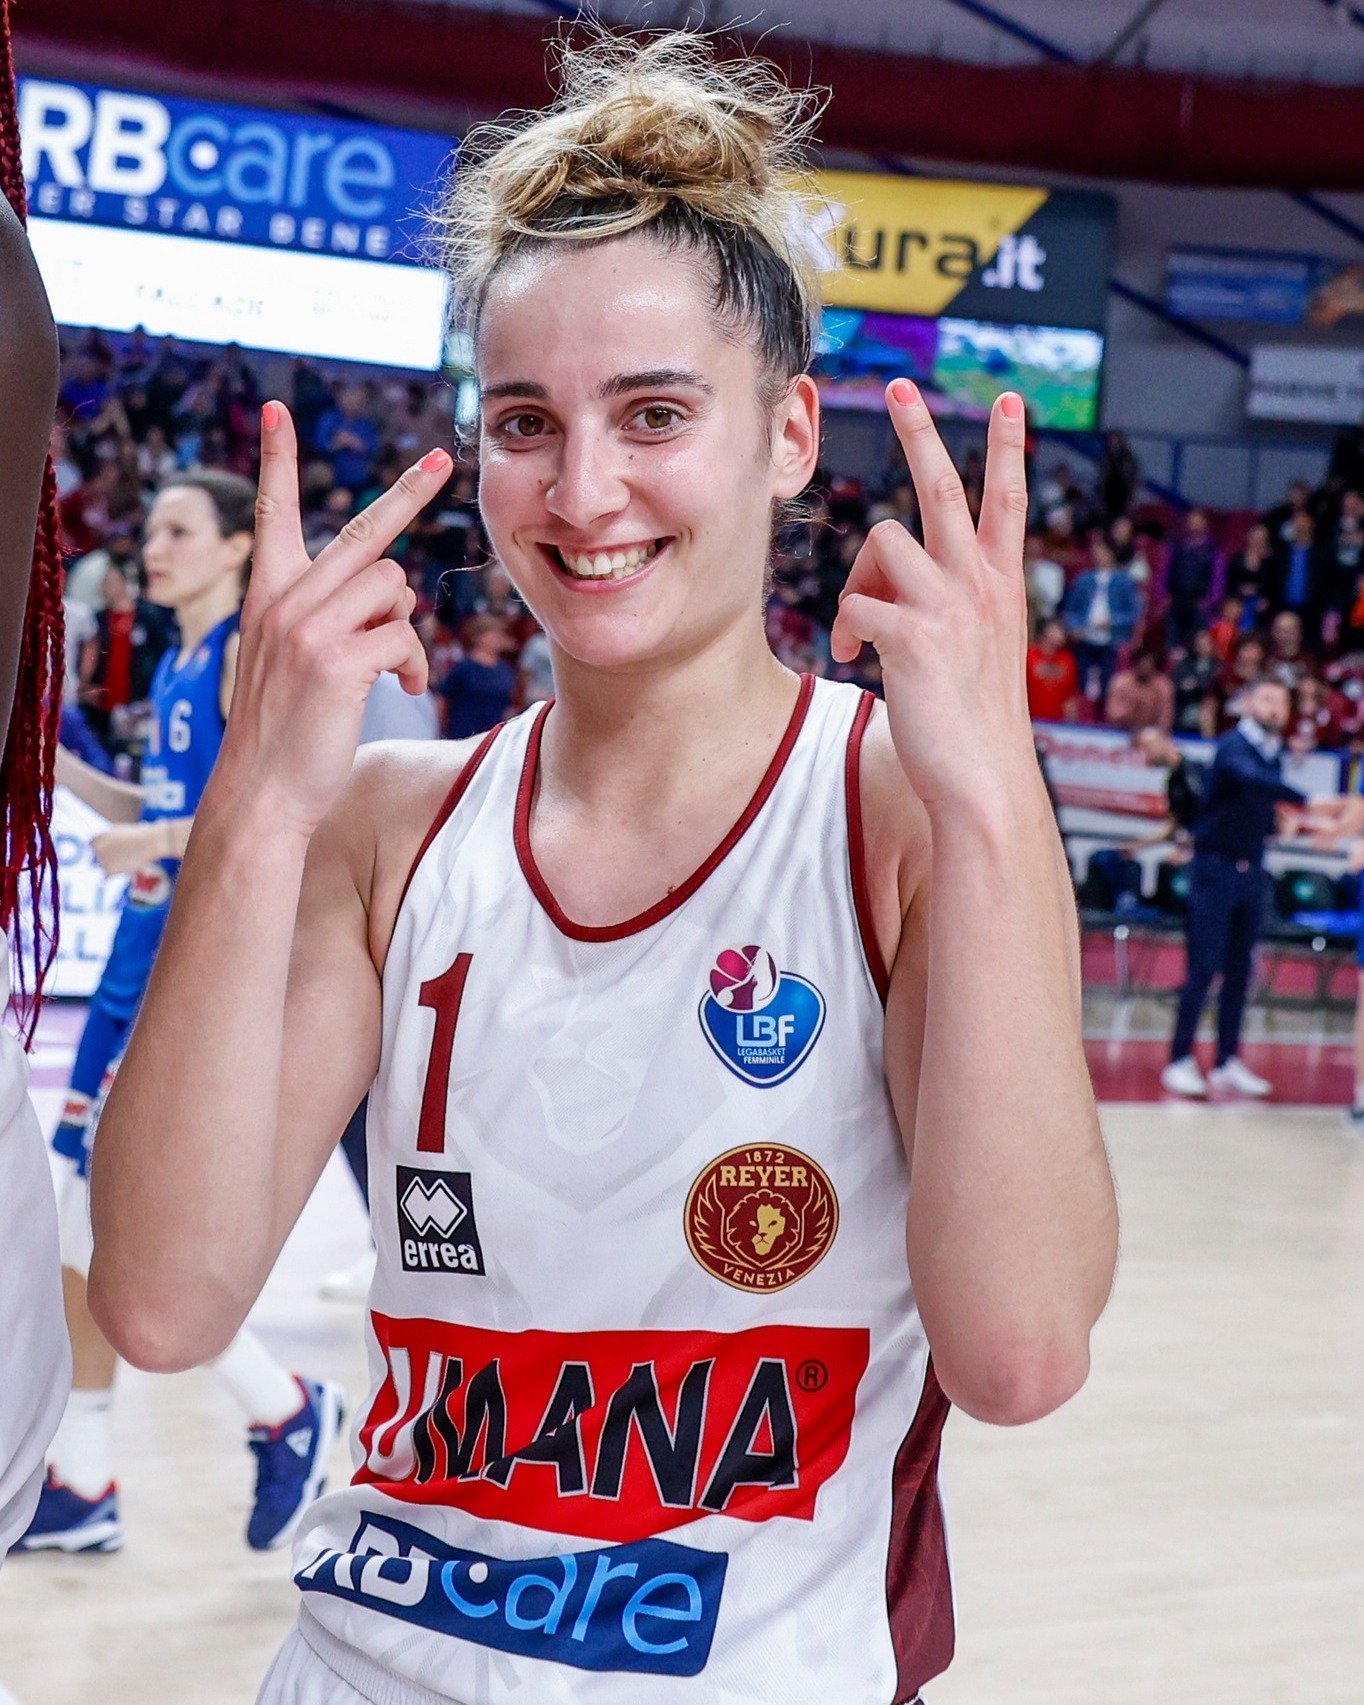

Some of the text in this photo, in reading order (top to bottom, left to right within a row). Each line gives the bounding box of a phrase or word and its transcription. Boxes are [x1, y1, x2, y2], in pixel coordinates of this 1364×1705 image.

[123, 196, 244, 238] STAR
[268, 212, 391, 257] BENE
[846, 226, 1047, 291] ura.it
[736, 1014, 795, 1047] LBF
[417, 952, 474, 1154] 1
[737, 1047, 786, 1056] LEGABASKET
[743, 1055, 785, 1065] FEMMINILE
[745, 1150, 785, 1164] 1872
[719, 1165, 808, 1187] REYER
[723, 1263, 796, 1286] VENEZIA
[366, 1346, 800, 1511] UMANA
